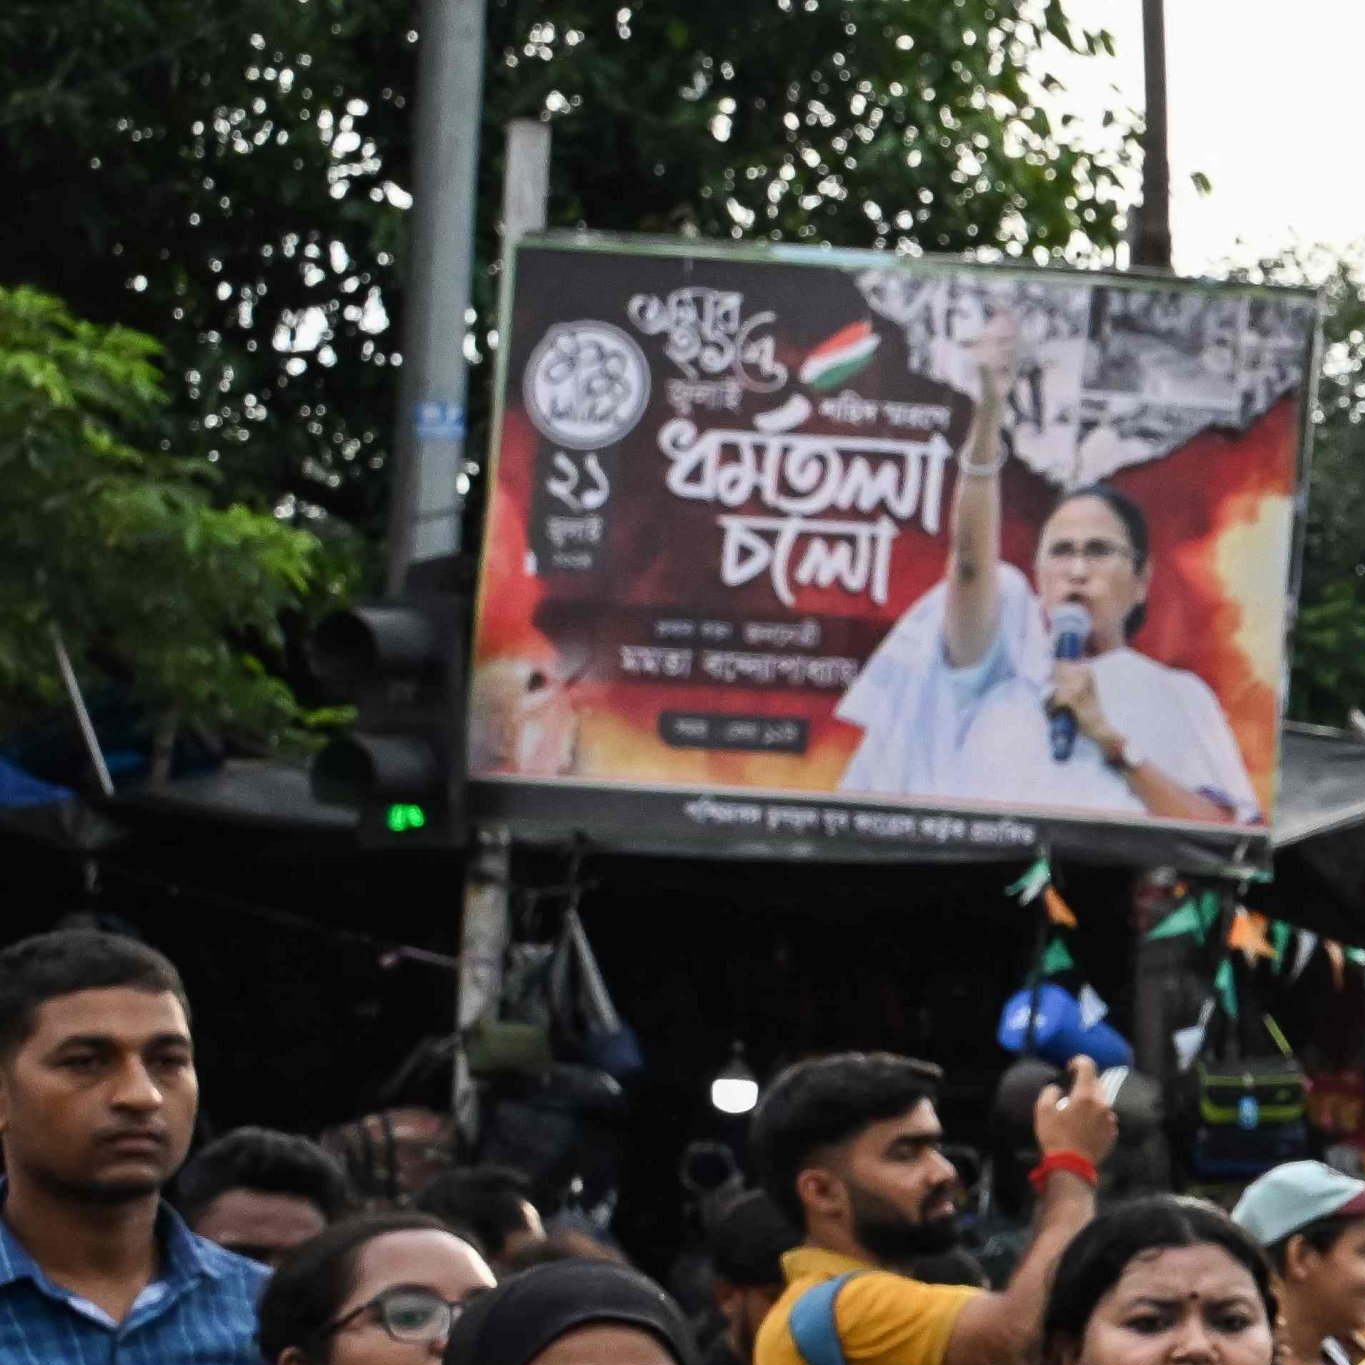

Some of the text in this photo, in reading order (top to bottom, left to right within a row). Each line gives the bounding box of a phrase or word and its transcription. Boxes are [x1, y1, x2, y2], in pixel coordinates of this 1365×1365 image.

[546, 451, 610, 512] ২১
[656, 393, 955, 534] ধর্মতলা
[718, 514, 897, 606] চলো
